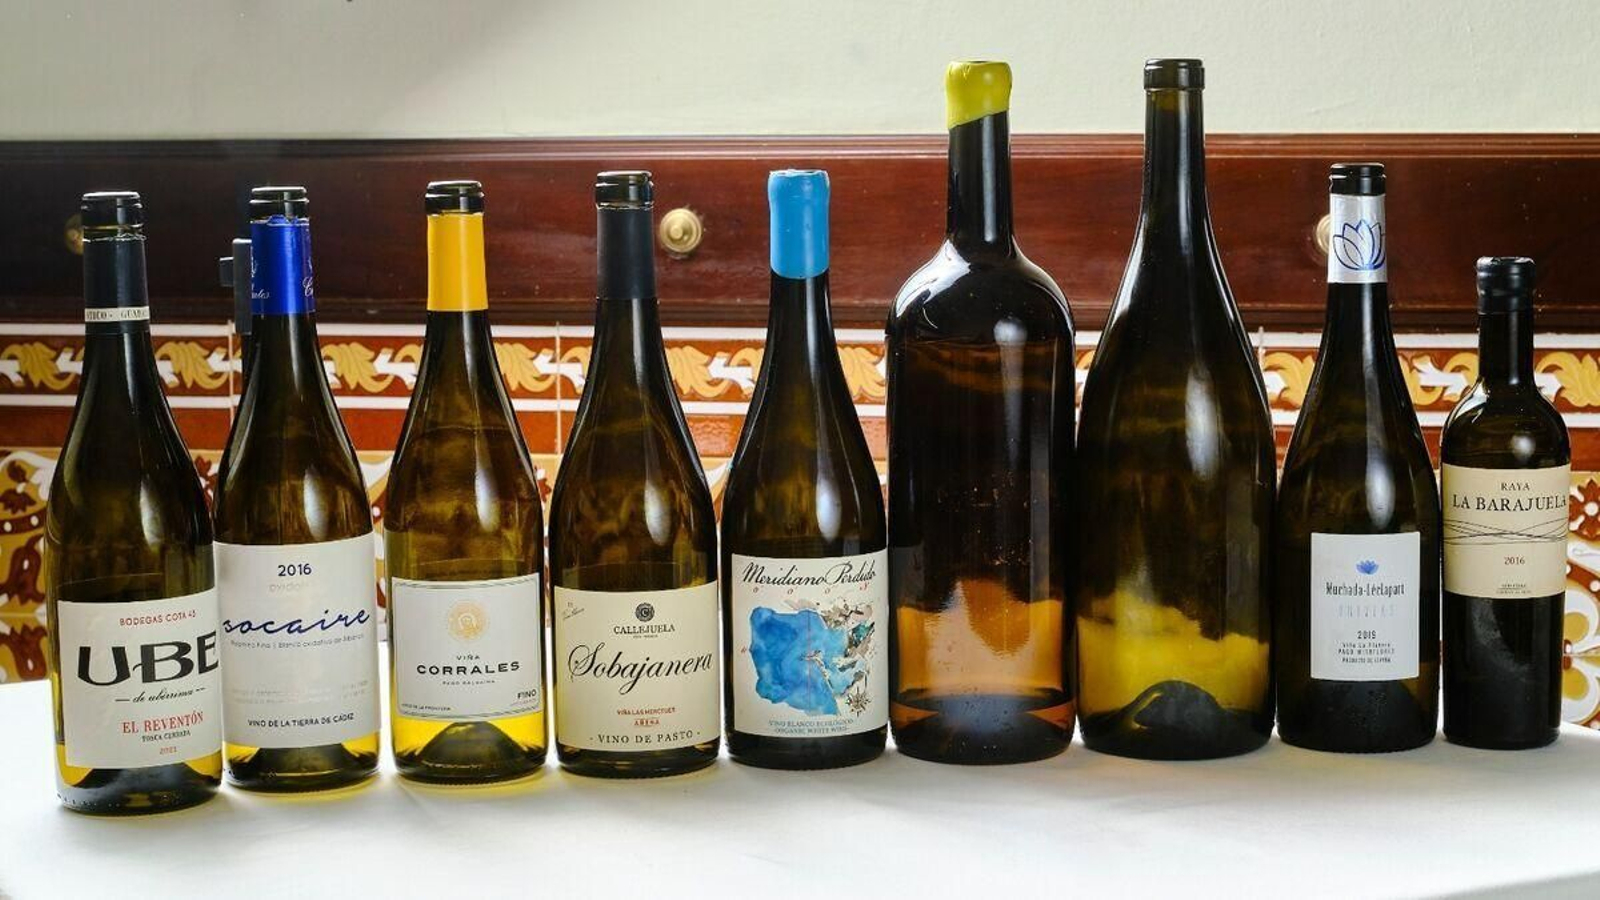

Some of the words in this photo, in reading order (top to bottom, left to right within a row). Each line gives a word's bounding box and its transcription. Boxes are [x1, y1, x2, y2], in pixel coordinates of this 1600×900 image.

[1501, 482, 1530, 491] RAYA
[1453, 494, 1470, 509] LA
[1476, 495, 1566, 511] BARAJUELA
[1504, 556, 1525, 565] 2016
[278, 563, 312, 577] 2016
[742, 562, 825, 586] Meridiano
[825, 559, 876, 585] Perdido
[119, 613, 163, 626] BODEGAS
[165, 611, 187, 622] COTA
[222, 608, 370, 635] socaire
[613, 624, 676, 635] CALLEJUELA
[77, 631, 219, 686] UBE
[456, 653, 480, 661] VIÑA
[416, 661, 520, 675] CORRALES
[568, 642, 713, 696] Sobajanera
[133, 691, 145, 703] de
[517, 689, 537, 699] FINO
[123, 720, 139, 734] EL
[144, 710, 204, 732] REVENTÓN
[247, 719, 266, 727] VINO
[268, 719, 279, 727] DE
[280, 719, 290, 727] LA
[291, 717, 319, 727] TIERRA
[321, 716, 330, 724] DE
[598, 733, 629, 744] VINO
[635, 733, 652, 744] DE
[657, 730, 694, 742] PASTO
